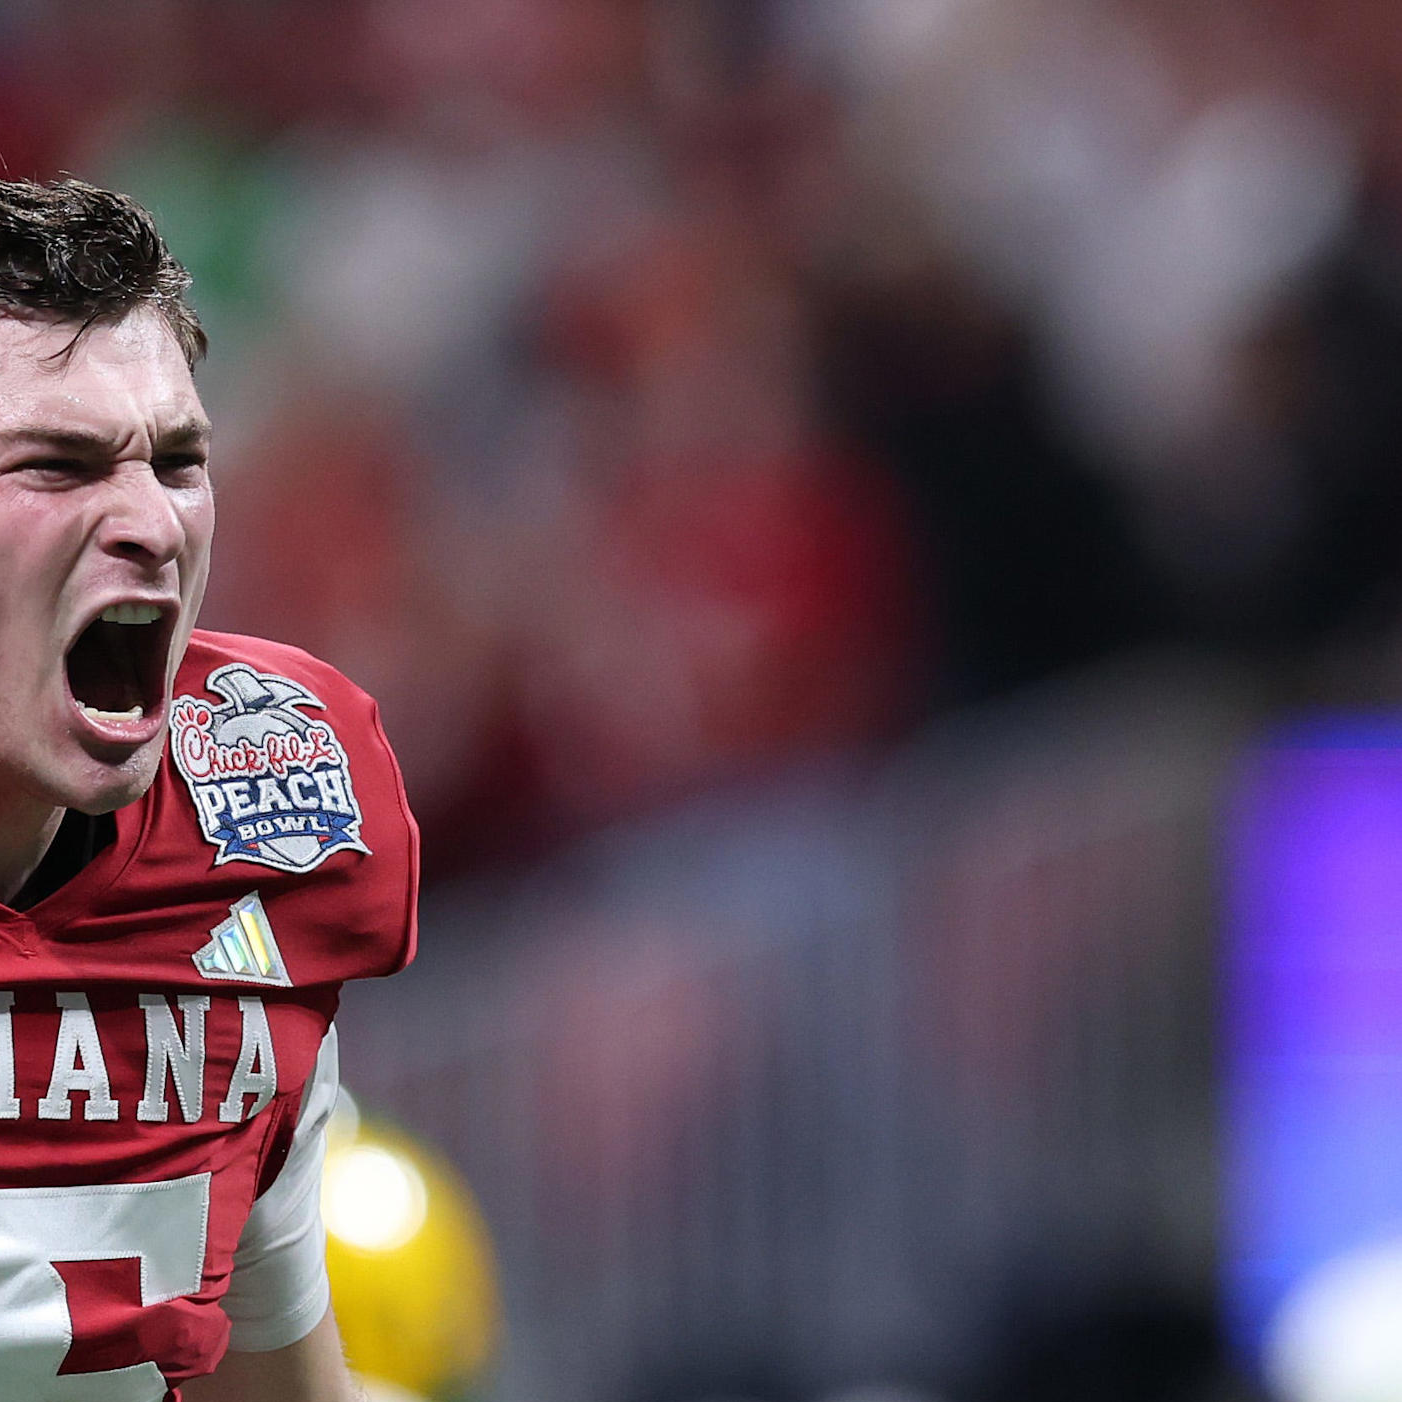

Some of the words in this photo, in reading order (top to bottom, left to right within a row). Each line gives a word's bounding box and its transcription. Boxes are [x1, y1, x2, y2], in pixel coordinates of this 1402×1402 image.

[179, 722, 336, 779] Chick-fil-A
[197, 768, 347, 829] PEACH
[237, 815, 330, 842] BOWL
